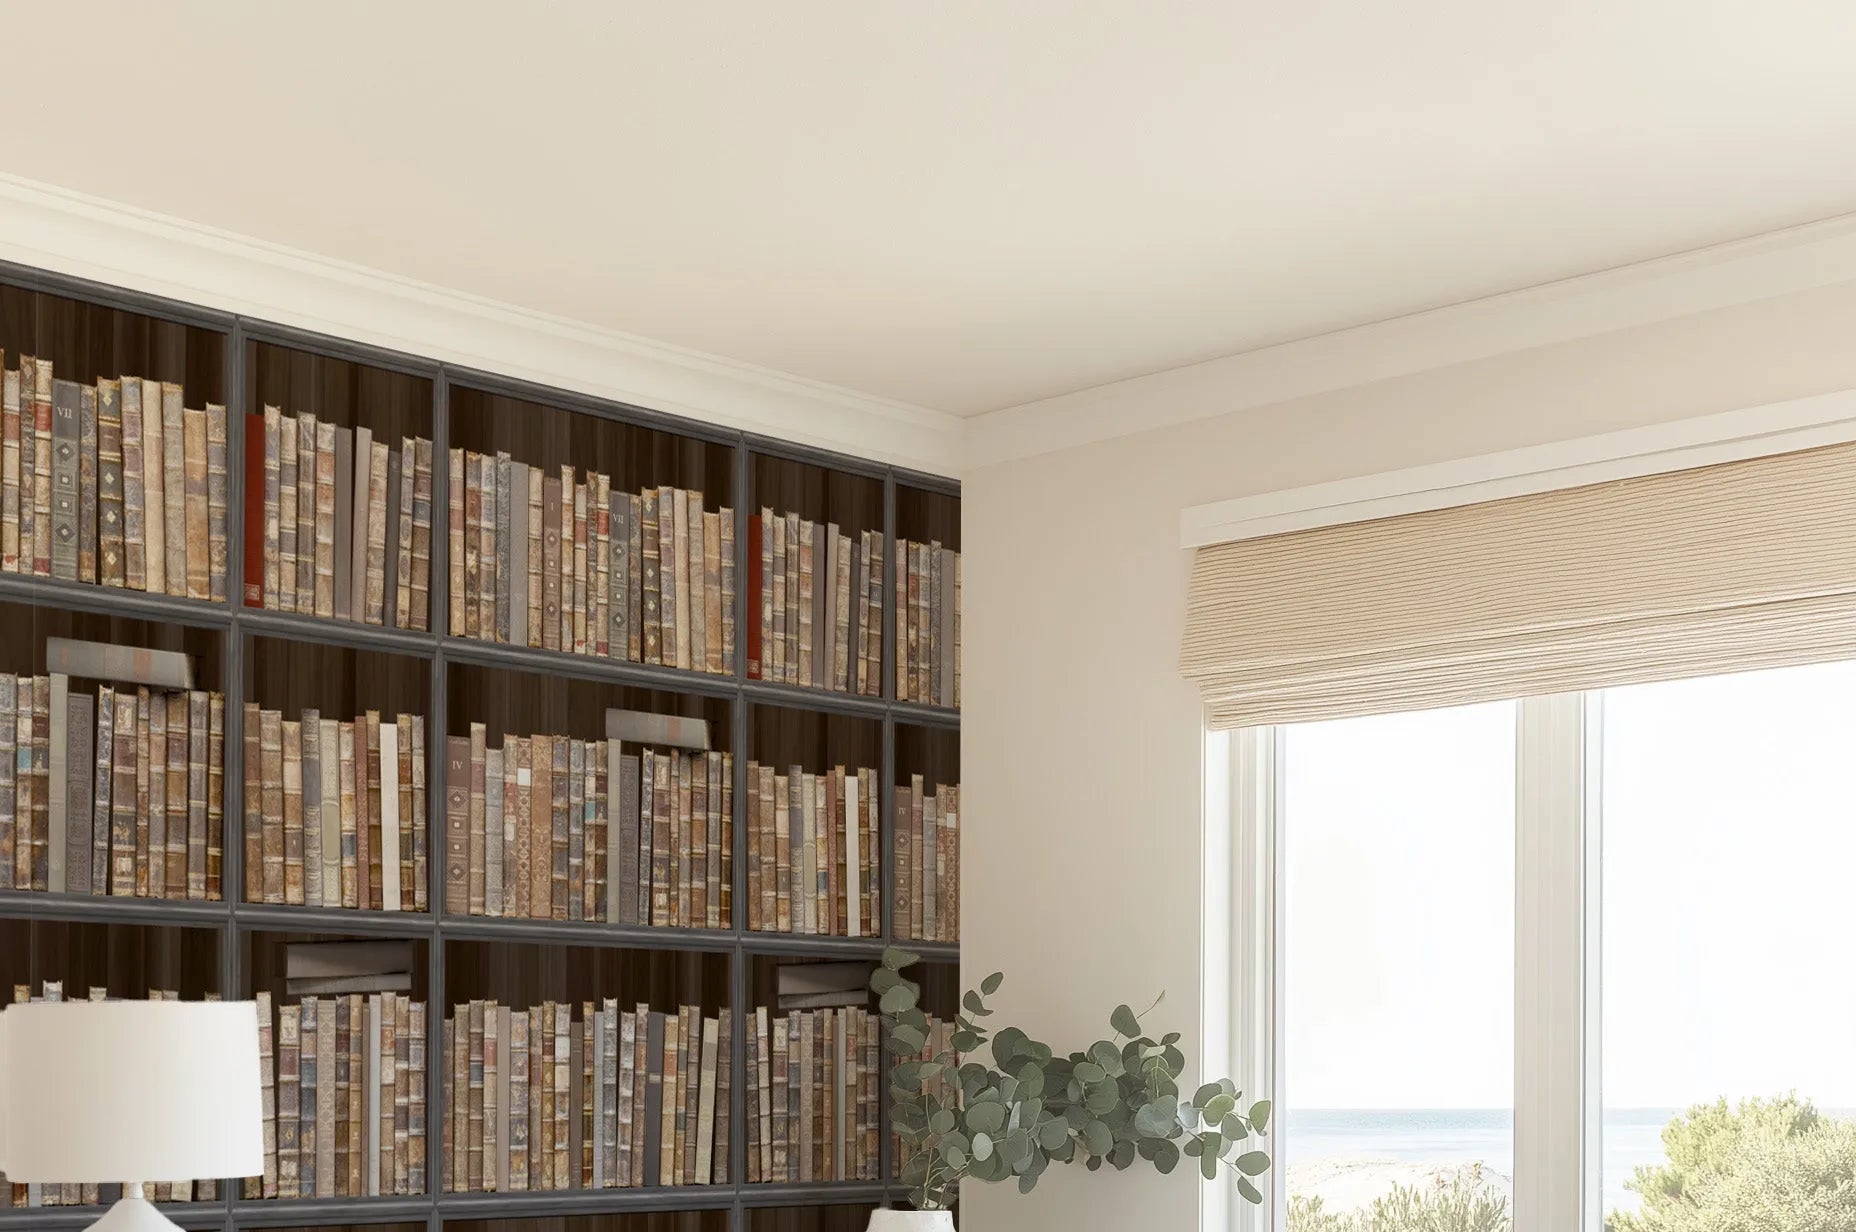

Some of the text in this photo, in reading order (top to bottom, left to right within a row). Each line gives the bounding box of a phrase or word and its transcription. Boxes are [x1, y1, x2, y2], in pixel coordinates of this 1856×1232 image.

[57, 406, 72, 419] VII
[612, 513, 624, 524] VII
[452, 760, 463, 771] IV
[898, 807, 906, 815] IV
